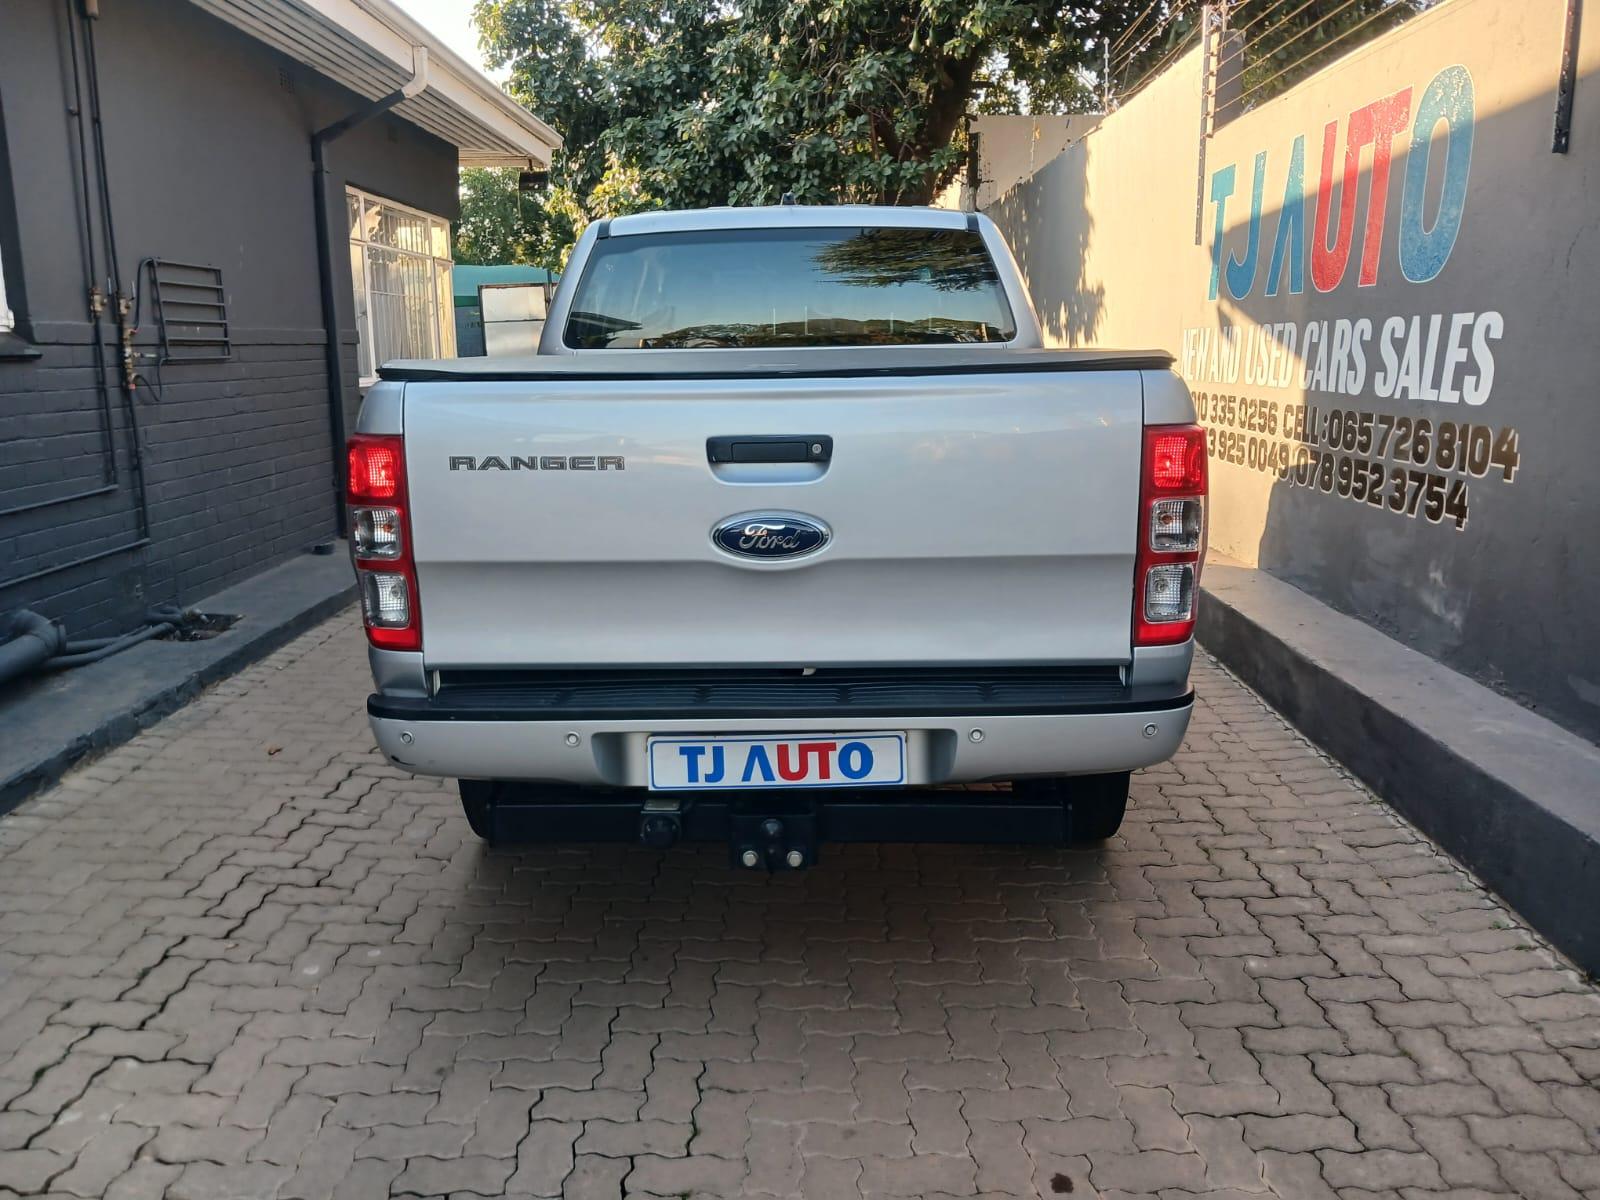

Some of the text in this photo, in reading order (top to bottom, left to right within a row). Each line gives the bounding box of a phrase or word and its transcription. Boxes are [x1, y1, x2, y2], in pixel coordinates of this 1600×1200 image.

[1208, 64, 1475, 301] TJ AUTO
[1182, 311, 1503, 406] NEW AND USED CARS SALES
[449, 455, 625, 471] RANGER
[1209, 393, 1237, 428] 335
[1238, 397, 1279, 436] 0256
[1377, 414, 1434, 468] 726
[1435, 421, 1521, 484] 8104
[1218, 430, 1247, 466] 925
[1337, 456, 1386, 509] 952
[1388, 466, 1470, 532] 3754
[738, 523, 800, 550] Ford
[679, 741, 874, 783] TJ AUTO
